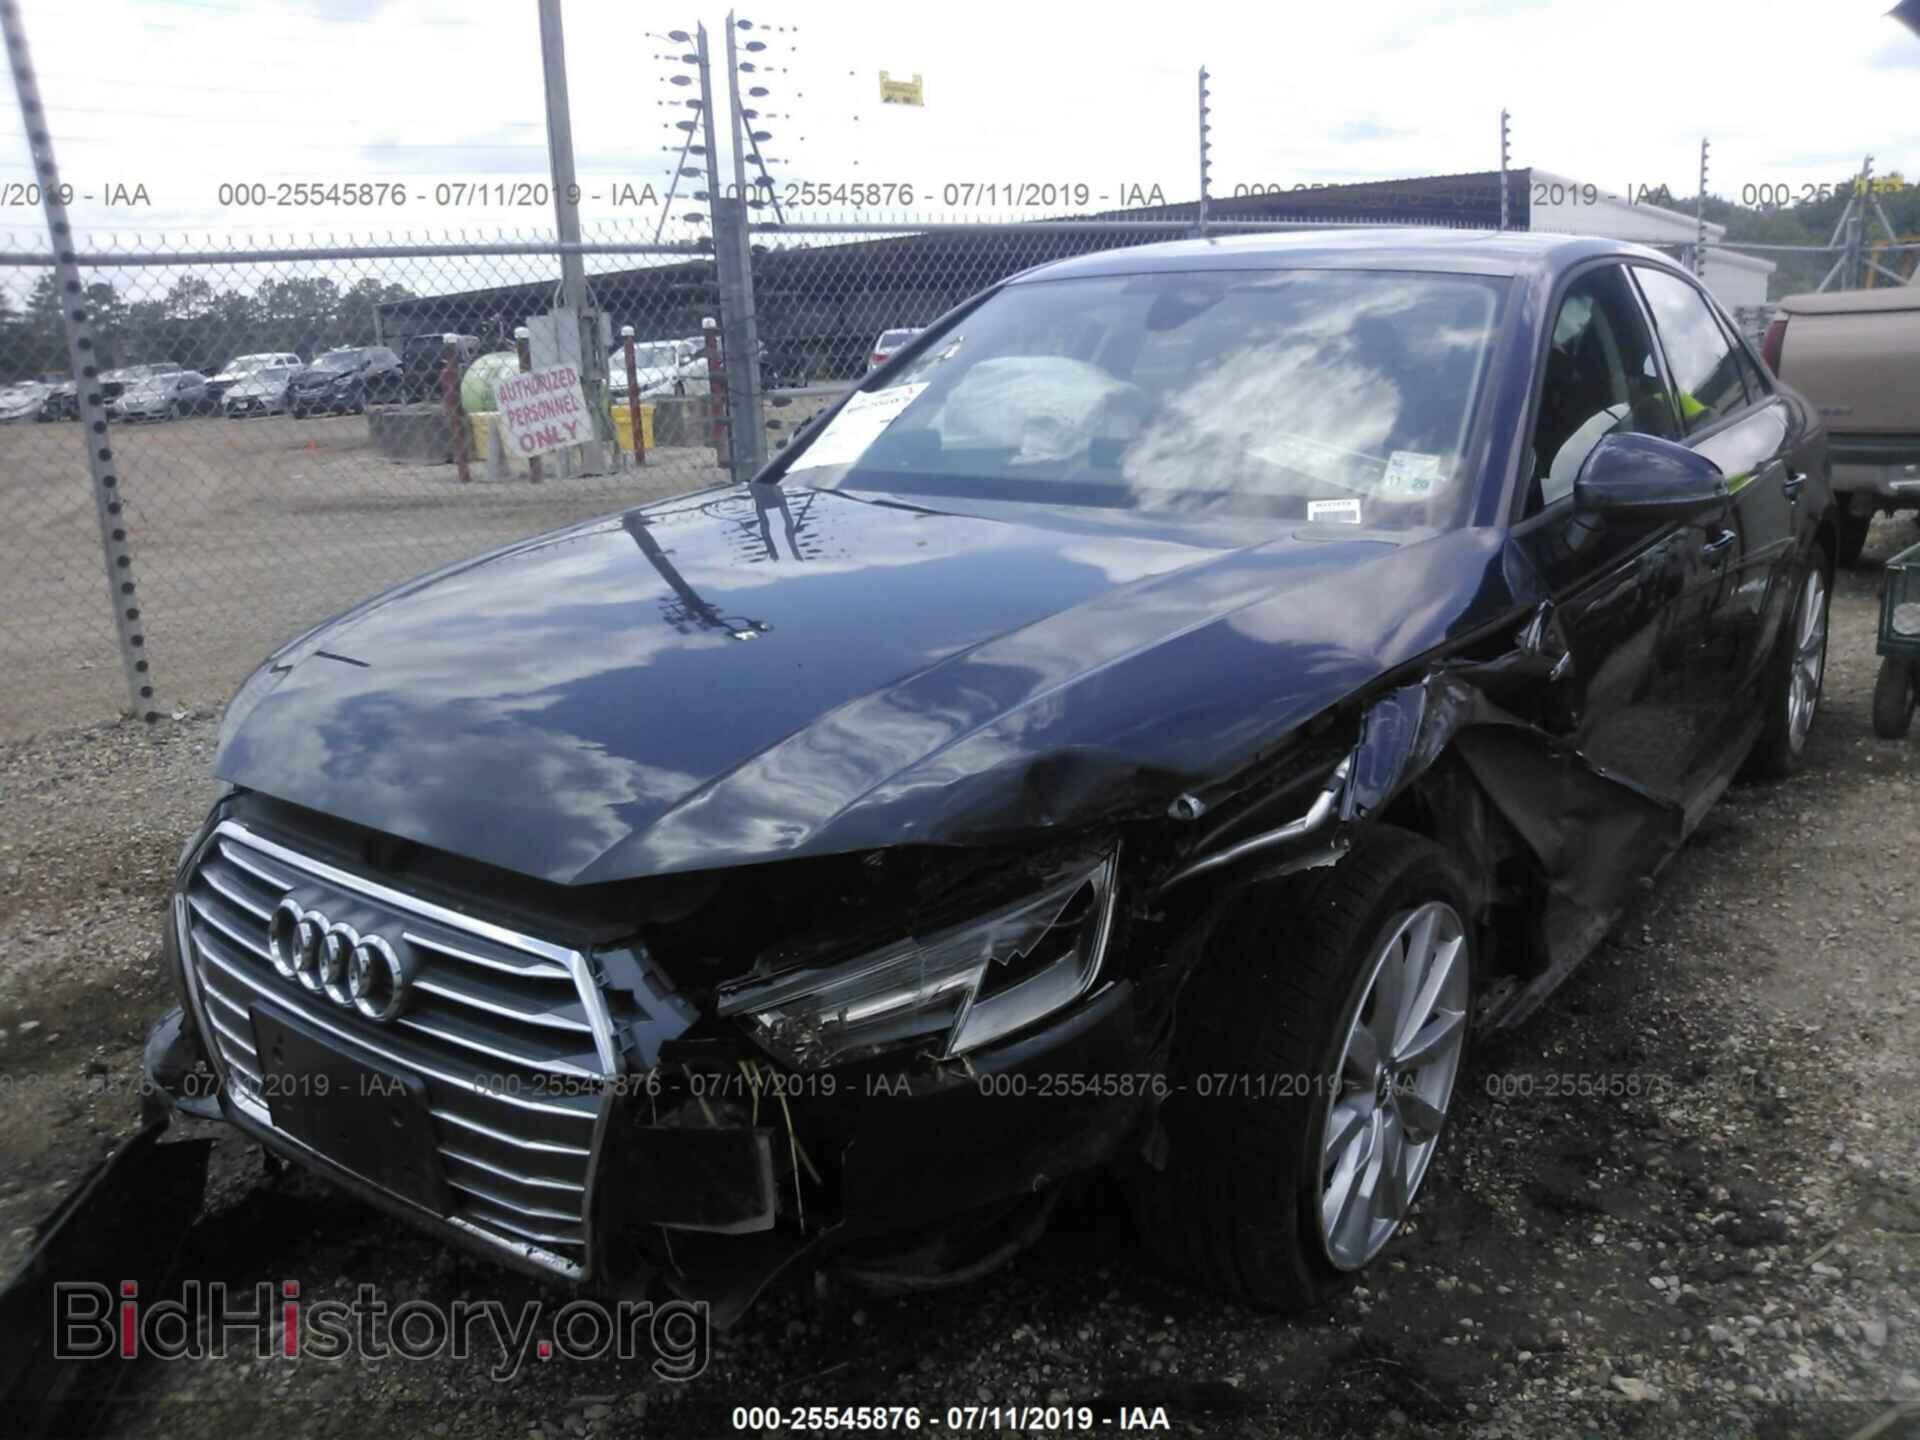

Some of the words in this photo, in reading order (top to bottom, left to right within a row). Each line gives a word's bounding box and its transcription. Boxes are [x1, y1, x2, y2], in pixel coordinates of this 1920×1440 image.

[499, 367, 577, 404] AUTHORIZED
[507, 392, 578, 428] PERSONNEL
[519, 421, 577, 453] ONLY
